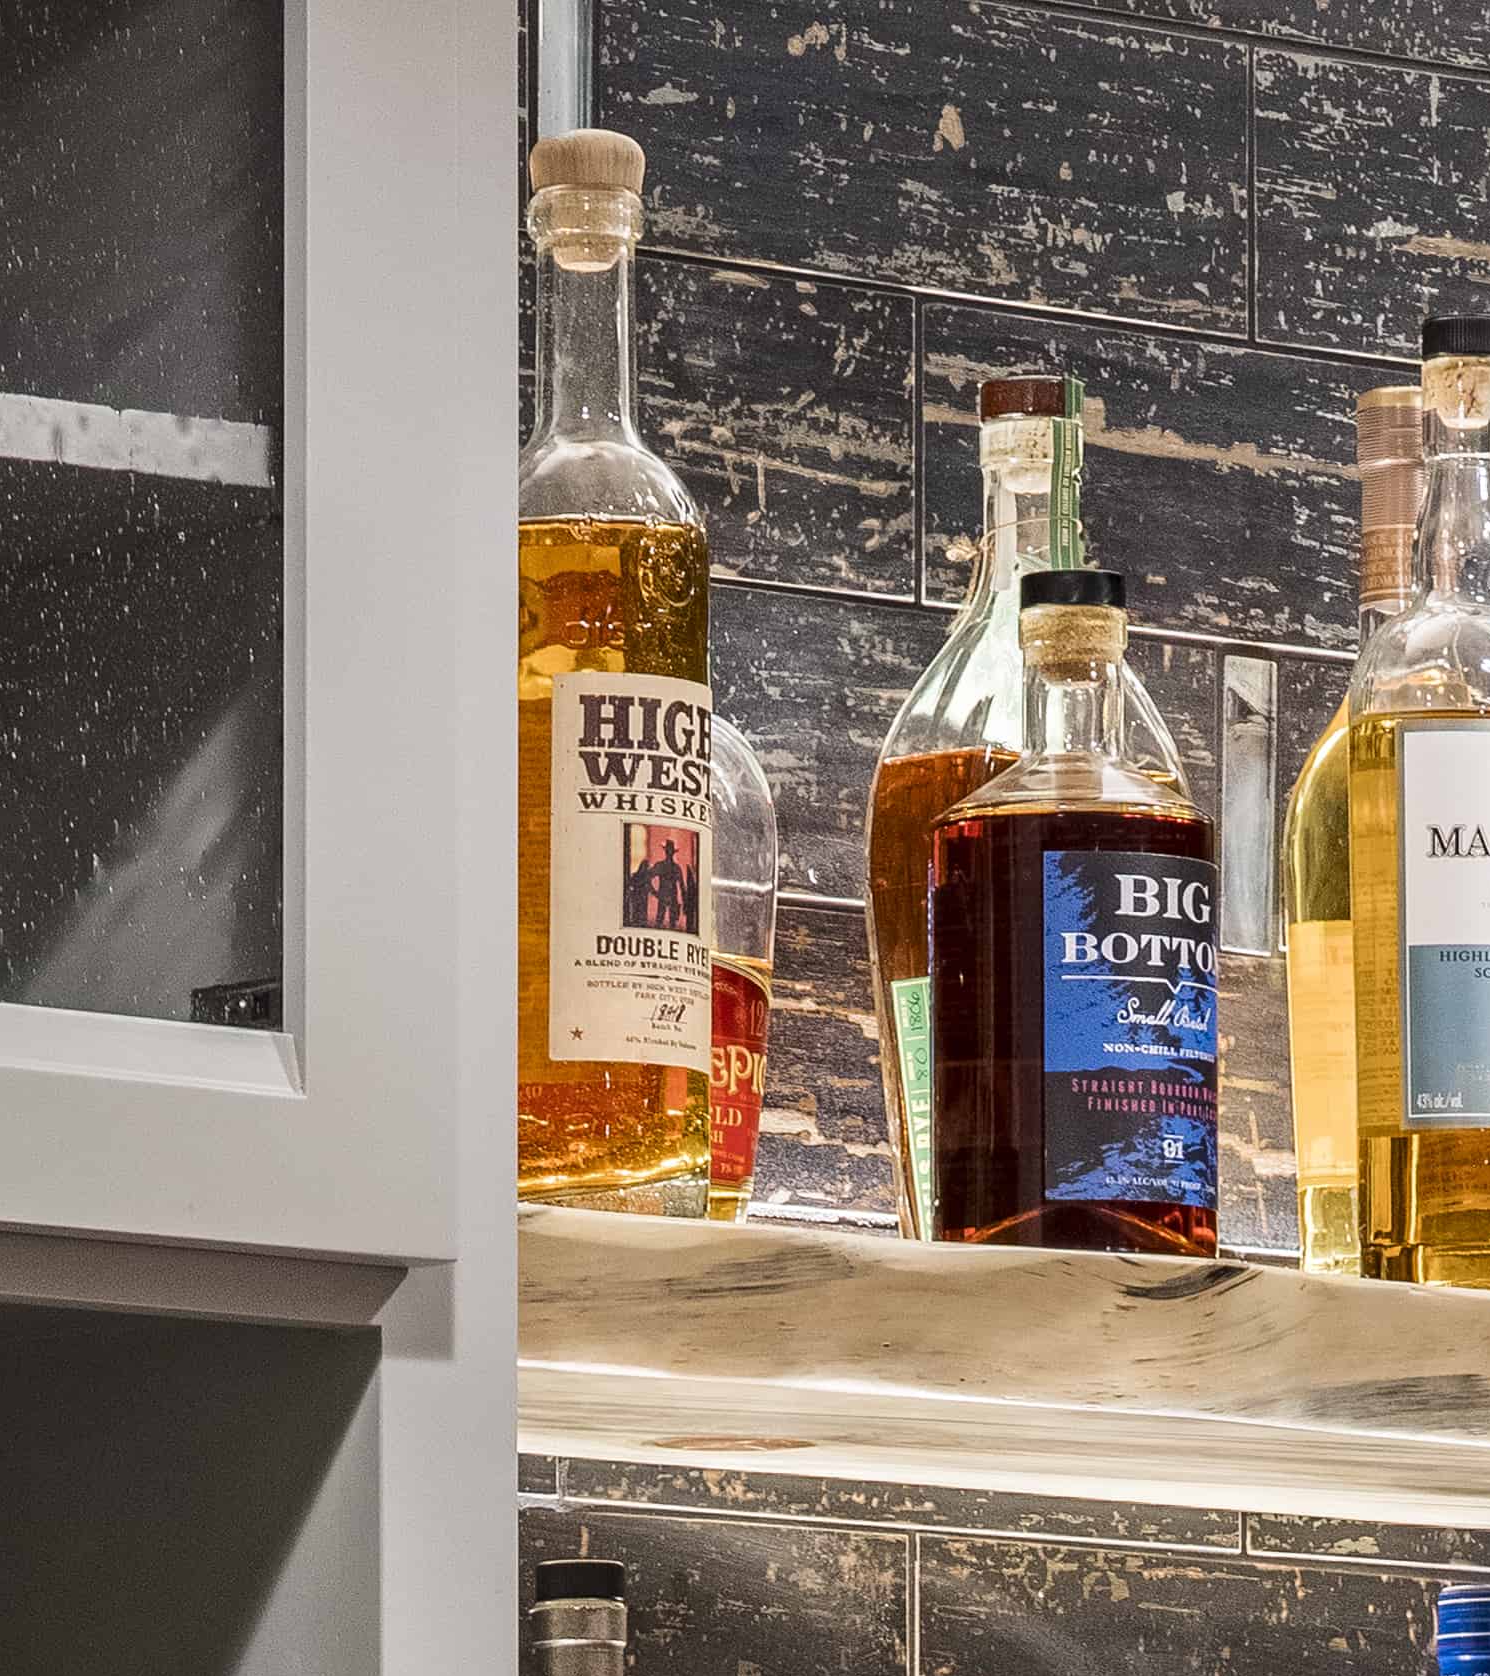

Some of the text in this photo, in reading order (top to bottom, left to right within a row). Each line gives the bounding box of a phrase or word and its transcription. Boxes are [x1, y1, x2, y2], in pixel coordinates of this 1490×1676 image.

[1114, 874, 1211, 923] BIG
[597, 936, 679, 961] DOUBLE
[1061, 932, 1217, 973] BOTTO
[1072, 1078, 1143, 1095] STRAIGHT
[1088, 1096, 1156, 1113] FINISHED
